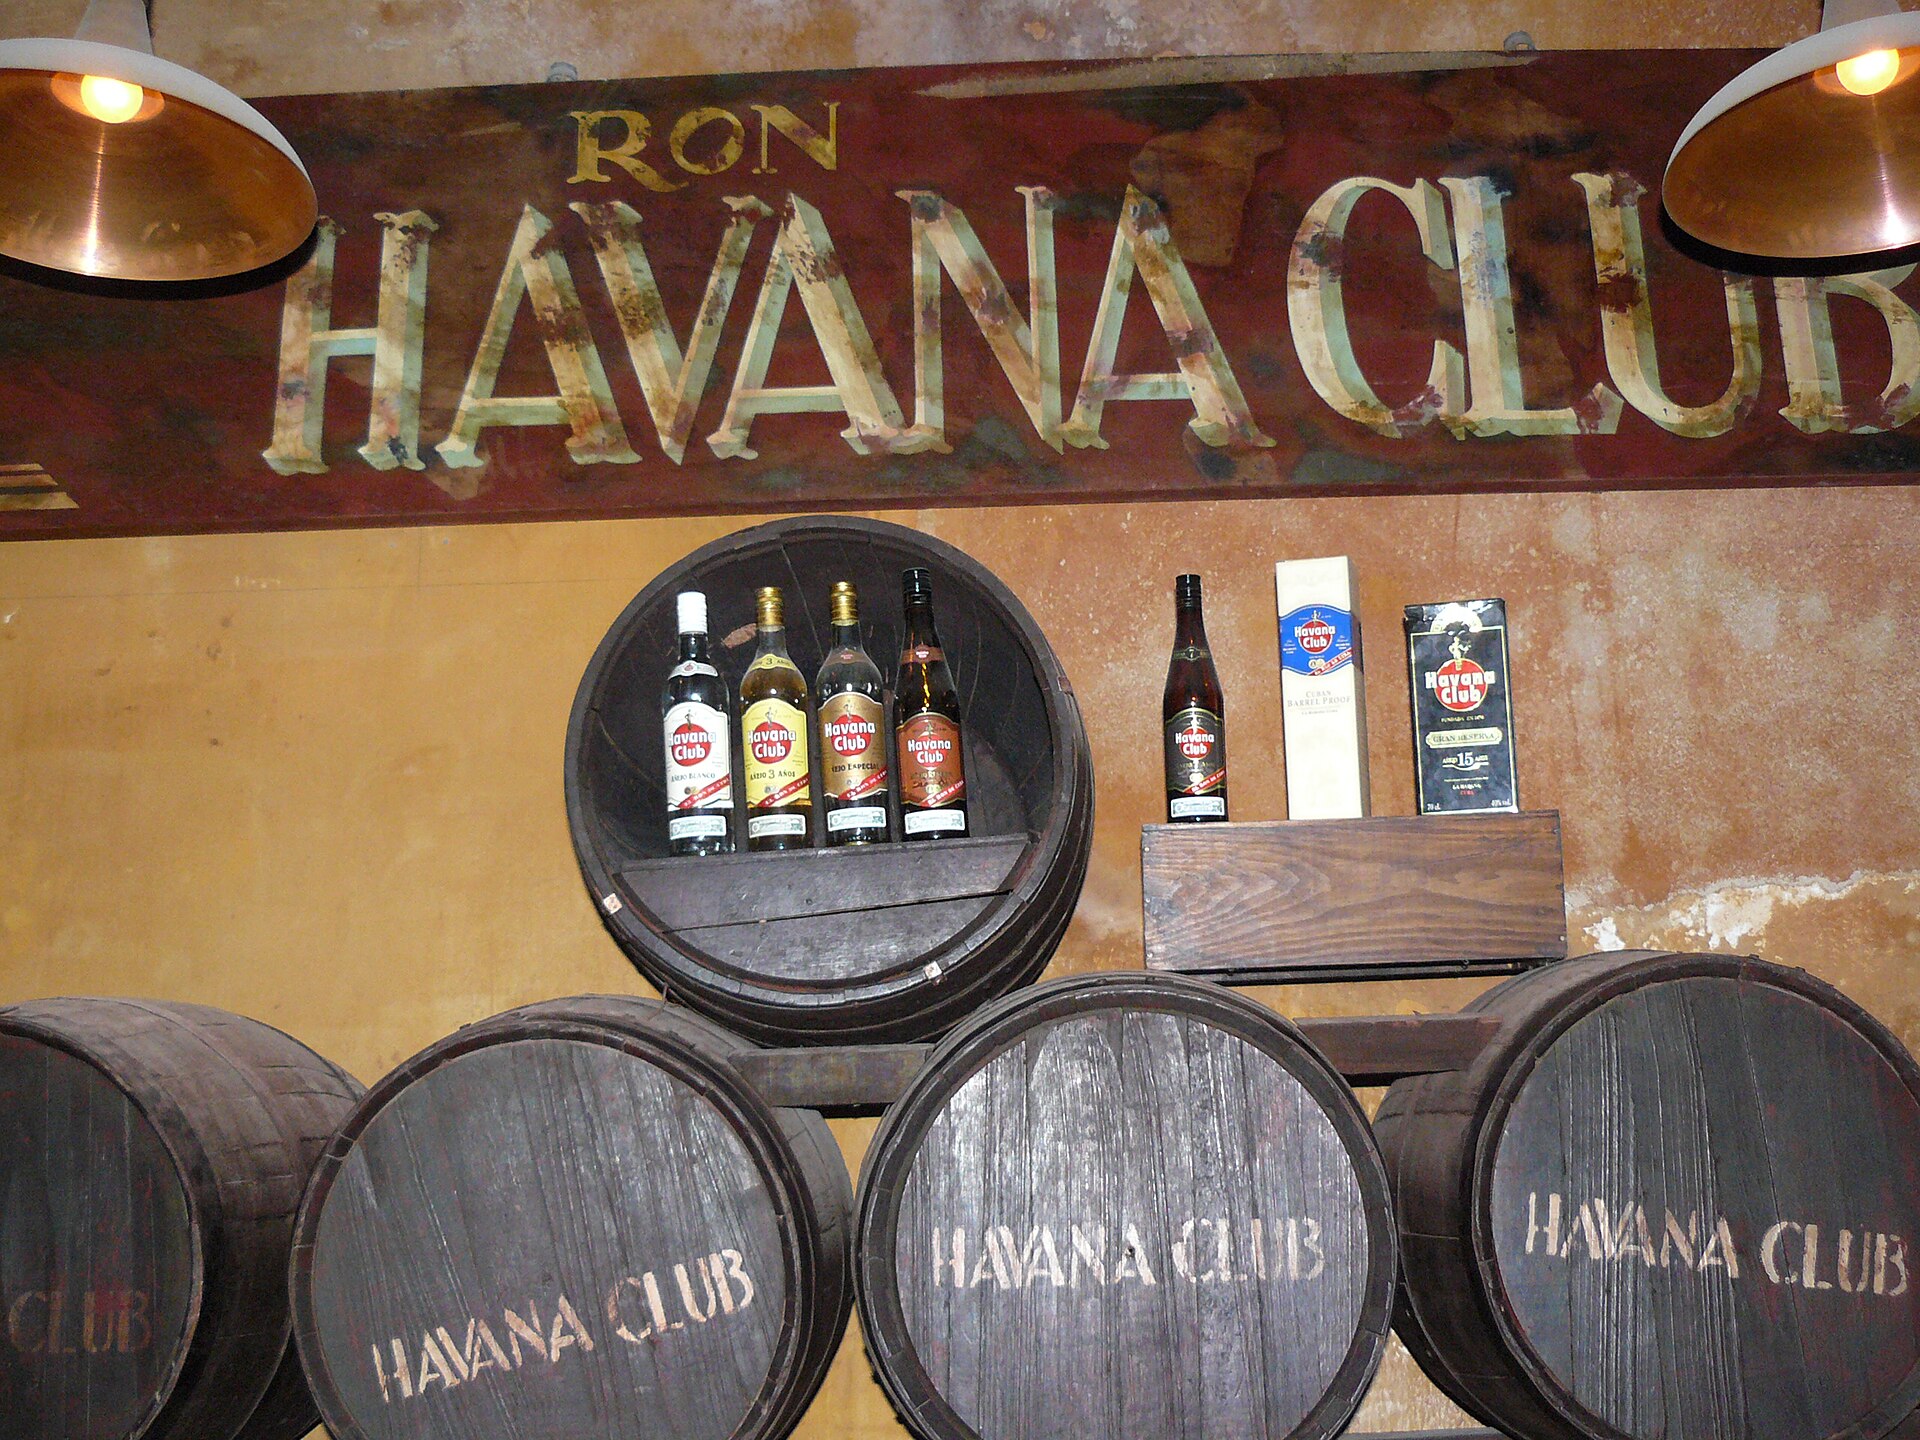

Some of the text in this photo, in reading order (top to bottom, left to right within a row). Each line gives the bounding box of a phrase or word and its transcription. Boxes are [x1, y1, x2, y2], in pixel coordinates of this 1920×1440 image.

[566, 102, 840, 193] RON
[261, 172, 1920, 476] HAVANA CLUB
[1294, 625, 1336, 637] Havana
[1303, 636, 1327, 648] Club
[1425, 671, 1496, 689] Havana
[1287, 695, 1351, 707] BARREL PROOF
[1305, 690, 1331, 698] CUBAN
[1440, 684, 1481, 704] Club
[824, 722, 876, 737] Havana
[747, 729, 797, 745] Havana
[834, 737, 866, 751] Club
[1175, 732, 1215, 744] Havana
[1433, 733, 1494, 743] GRAN RESERVA
[674, 743, 706, 761] Club
[755, 742, 786, 758] Club
[907, 739, 952, 752] Havana
[1183, 743, 1207, 755] Club
[917, 751, 943, 763] Club
[1457, 752, 1474, 766] 15
[768, 769, 775, 779] 3
[1525, 1193, 1911, 1297] HAVANA CLUB
[932, 1216, 1323, 1291] HAVANA CLUB
[8, 1288, 152, 1353] CLUB
[371, 1248, 754, 1403] HAVANA CLUB
